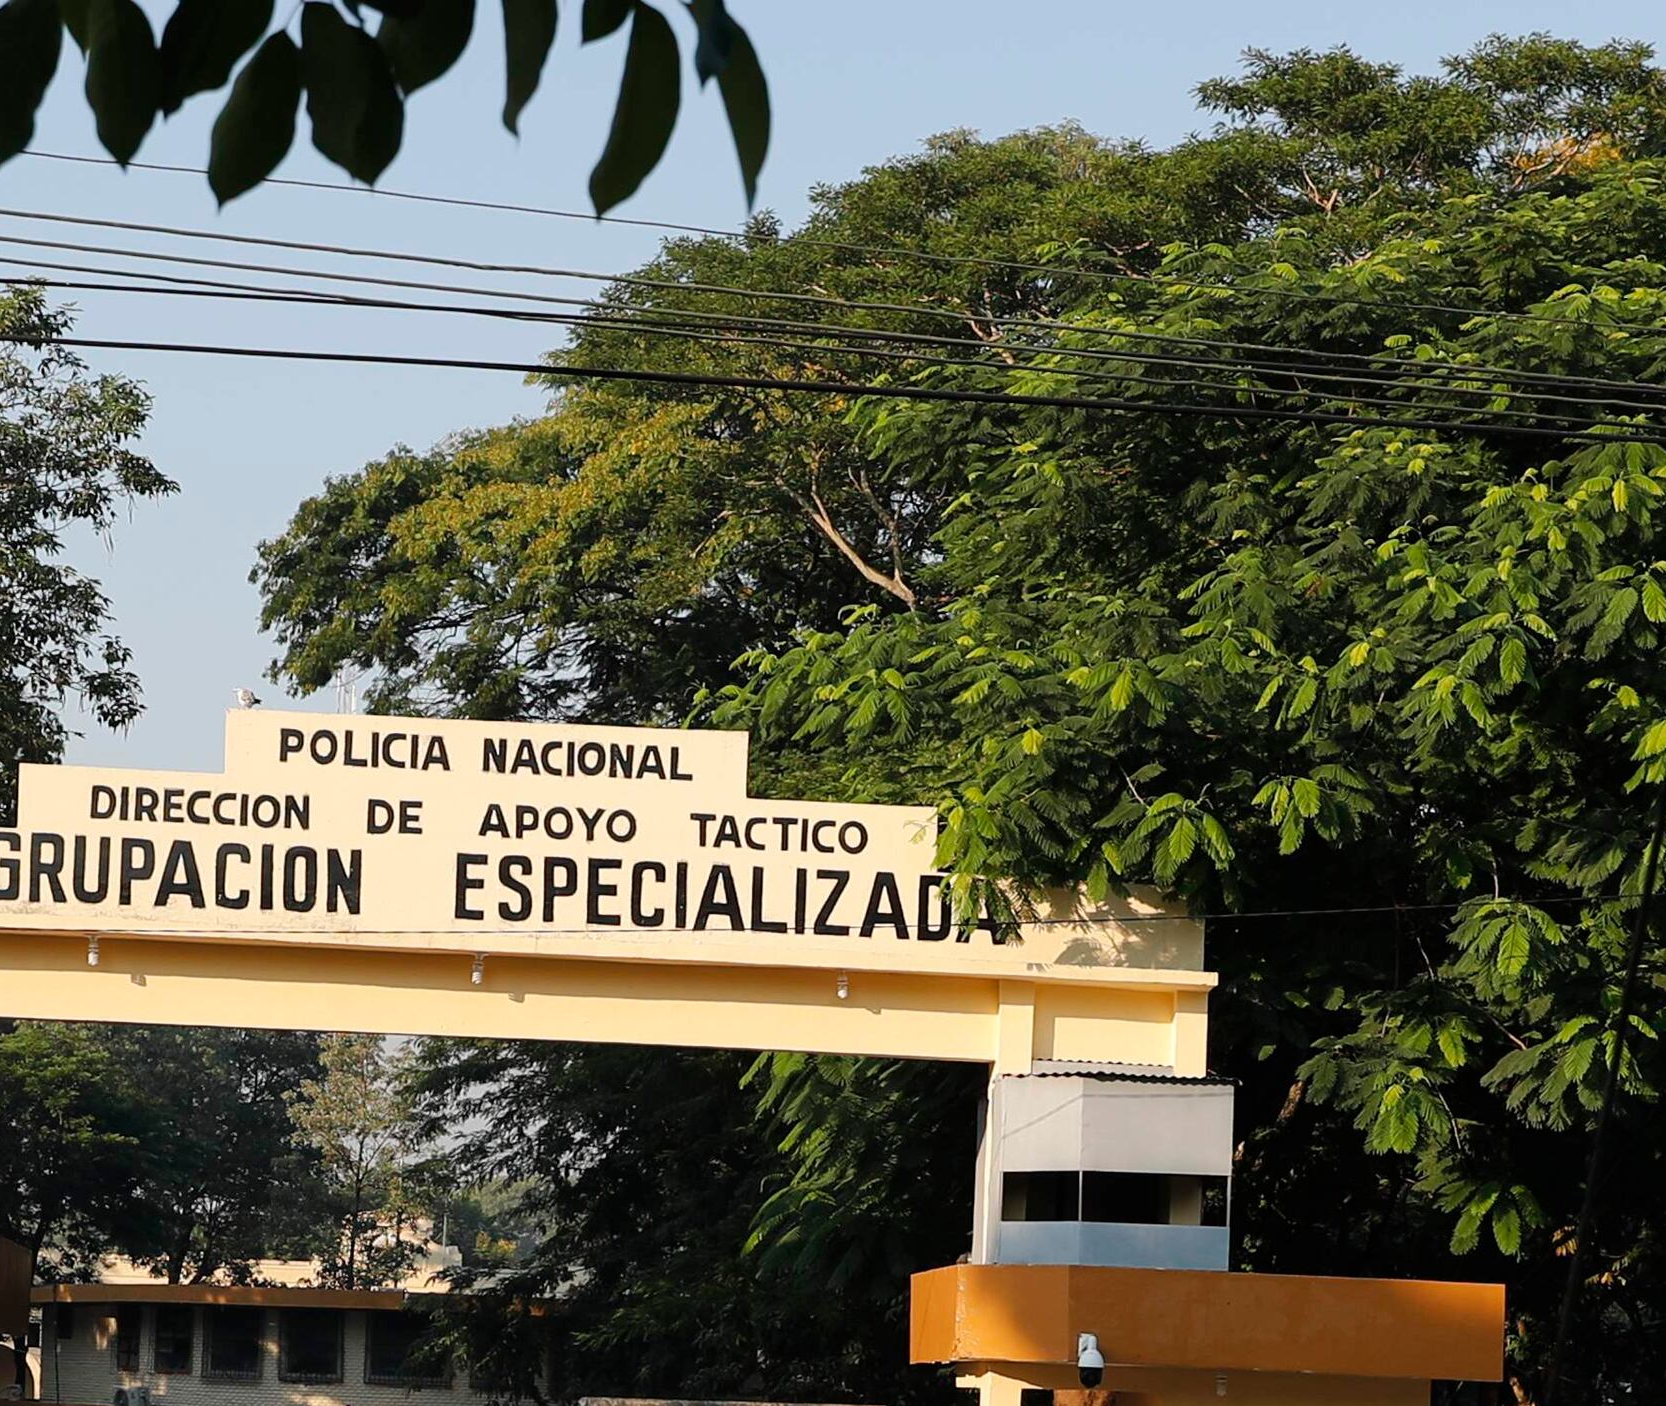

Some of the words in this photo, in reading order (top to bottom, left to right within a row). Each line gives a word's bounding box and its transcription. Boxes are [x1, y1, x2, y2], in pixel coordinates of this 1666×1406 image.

[279, 727, 451, 772] POLICIA
[482, 738, 693, 781] NACIONAL
[90, 785, 310, 830] DIRECCION
[367, 798, 424, 834] DE
[478, 804, 637, 842] APOYO
[692, 813, 868, 853] TACTICO
